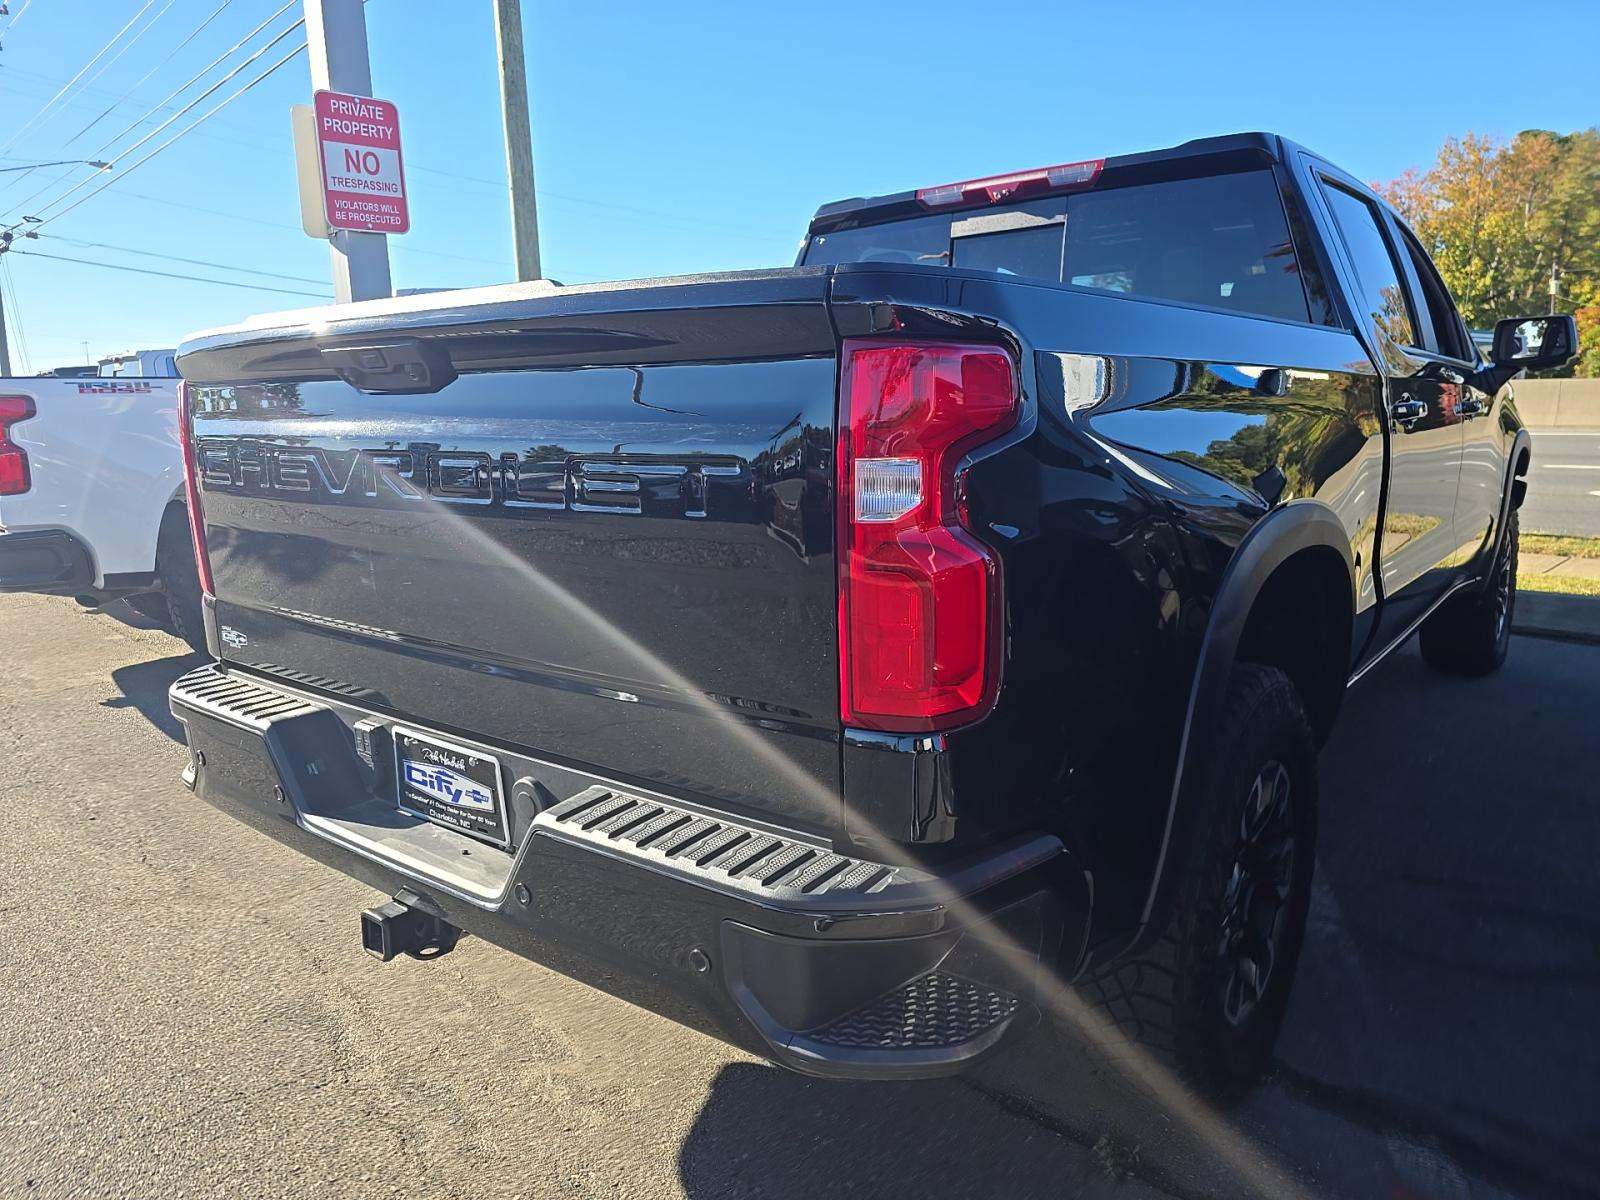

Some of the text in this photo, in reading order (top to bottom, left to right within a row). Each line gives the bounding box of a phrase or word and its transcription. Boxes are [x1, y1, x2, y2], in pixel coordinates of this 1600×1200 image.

[330, 99, 384, 121] PRIVATE
[323, 117, 393, 140] PROPERTY
[344, 148, 380, 176] NO
[331, 176, 399, 193] TRESPASSING
[334, 199, 400, 214] VIOLATORS WILL
[335, 211, 401, 225] BE PROSECUTED
[200, 437, 746, 519] CHEVROLET
[460, 819, 471, 829] NC
